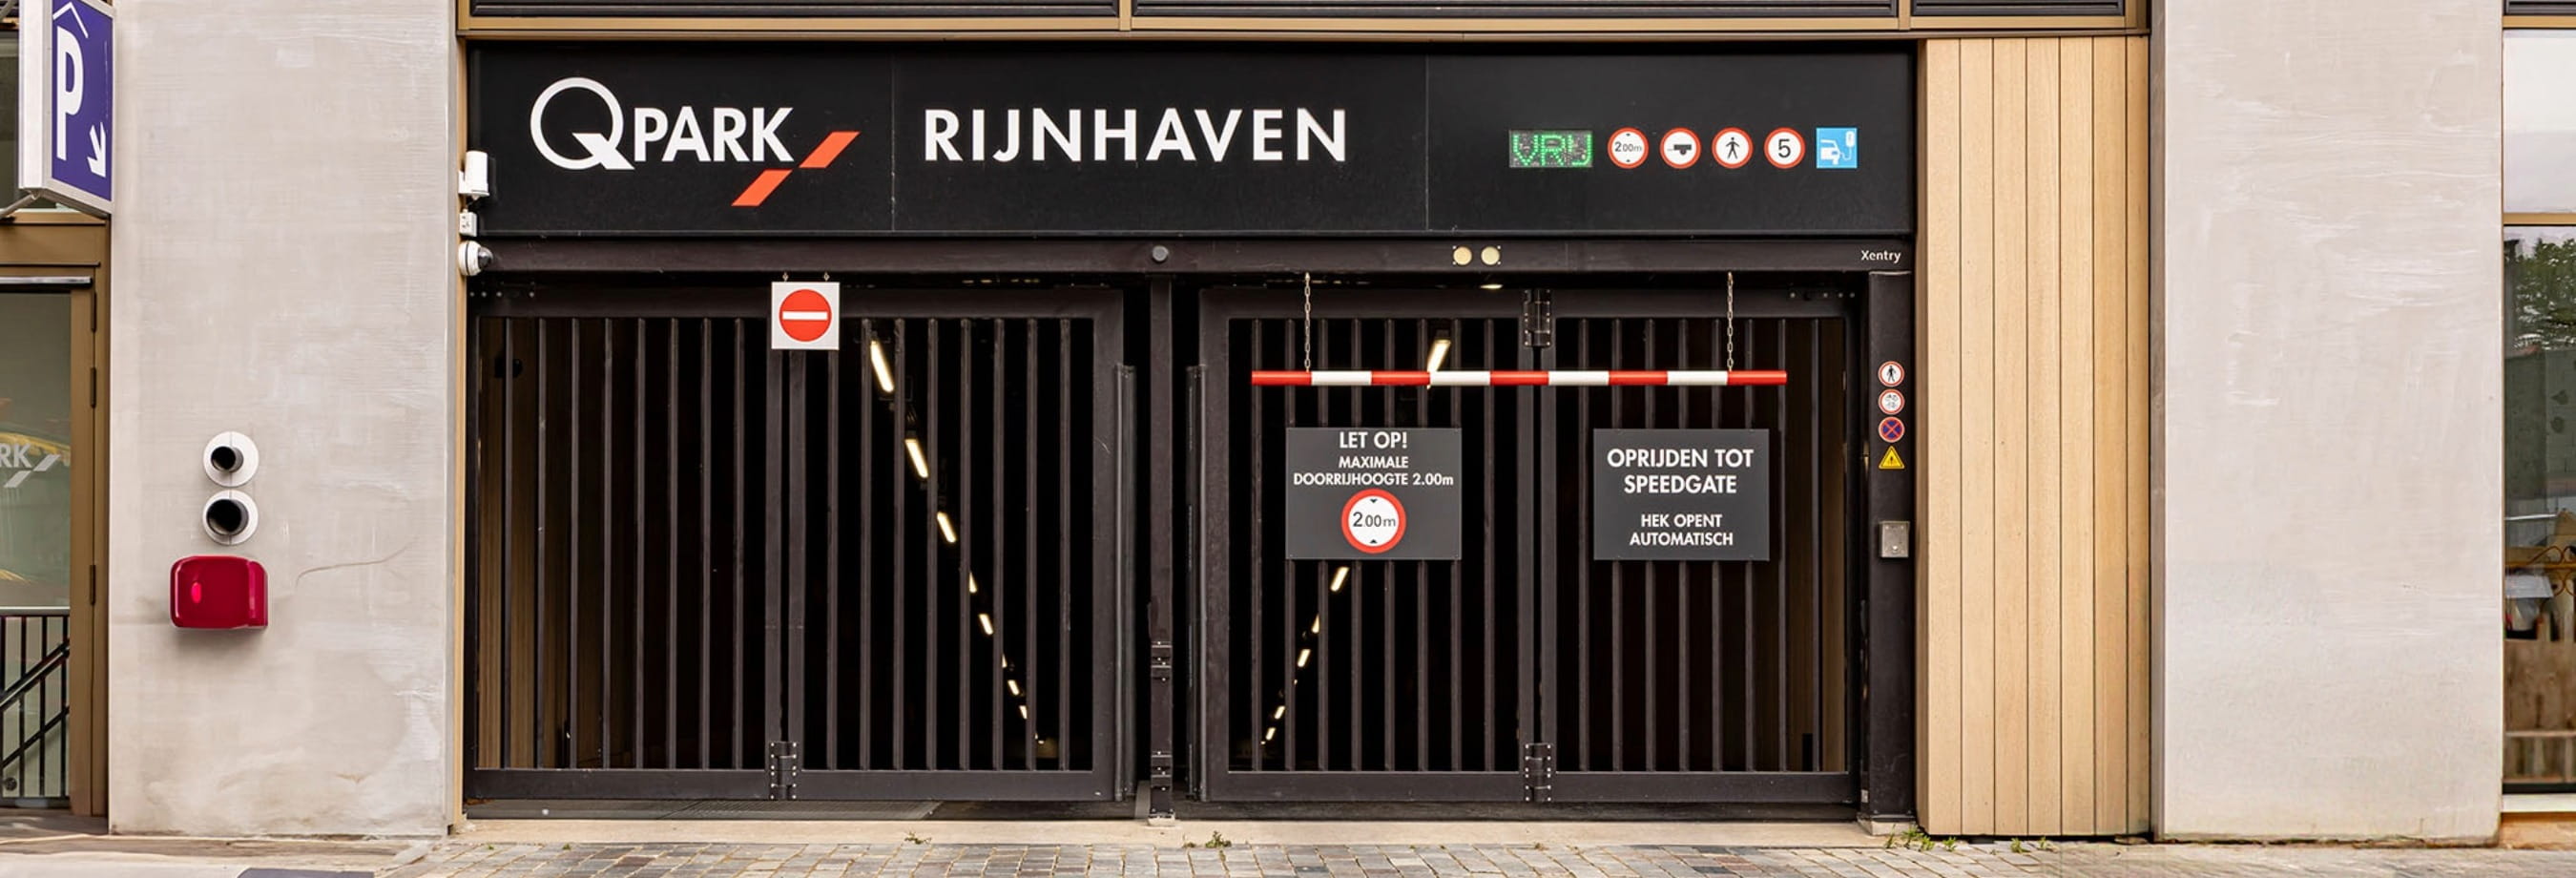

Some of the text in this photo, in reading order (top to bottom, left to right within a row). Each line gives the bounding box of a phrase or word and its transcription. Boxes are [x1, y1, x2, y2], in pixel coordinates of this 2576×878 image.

[56, 26, 84, 161] P
[924, 108, 1346, 162] RIJNHAVEN
[1778, 138, 1791, 157] 5
[1860, 249, 1901, 264] Xentry
[1339, 431, 1407, 449] LET OP!
[1338, 456, 1409, 469] MAXIMALE
[1607, 448, 1755, 468] OPRIJDEN TOT
[1293, 472, 1454, 486] DOORRIJHOOGTE 2.00m
[1624, 474, 1737, 494] SPEEDGATE
[1641, 513, 1723, 528] HEK OPENT
[1629, 532, 1734, 546] AUTOMATISCH
